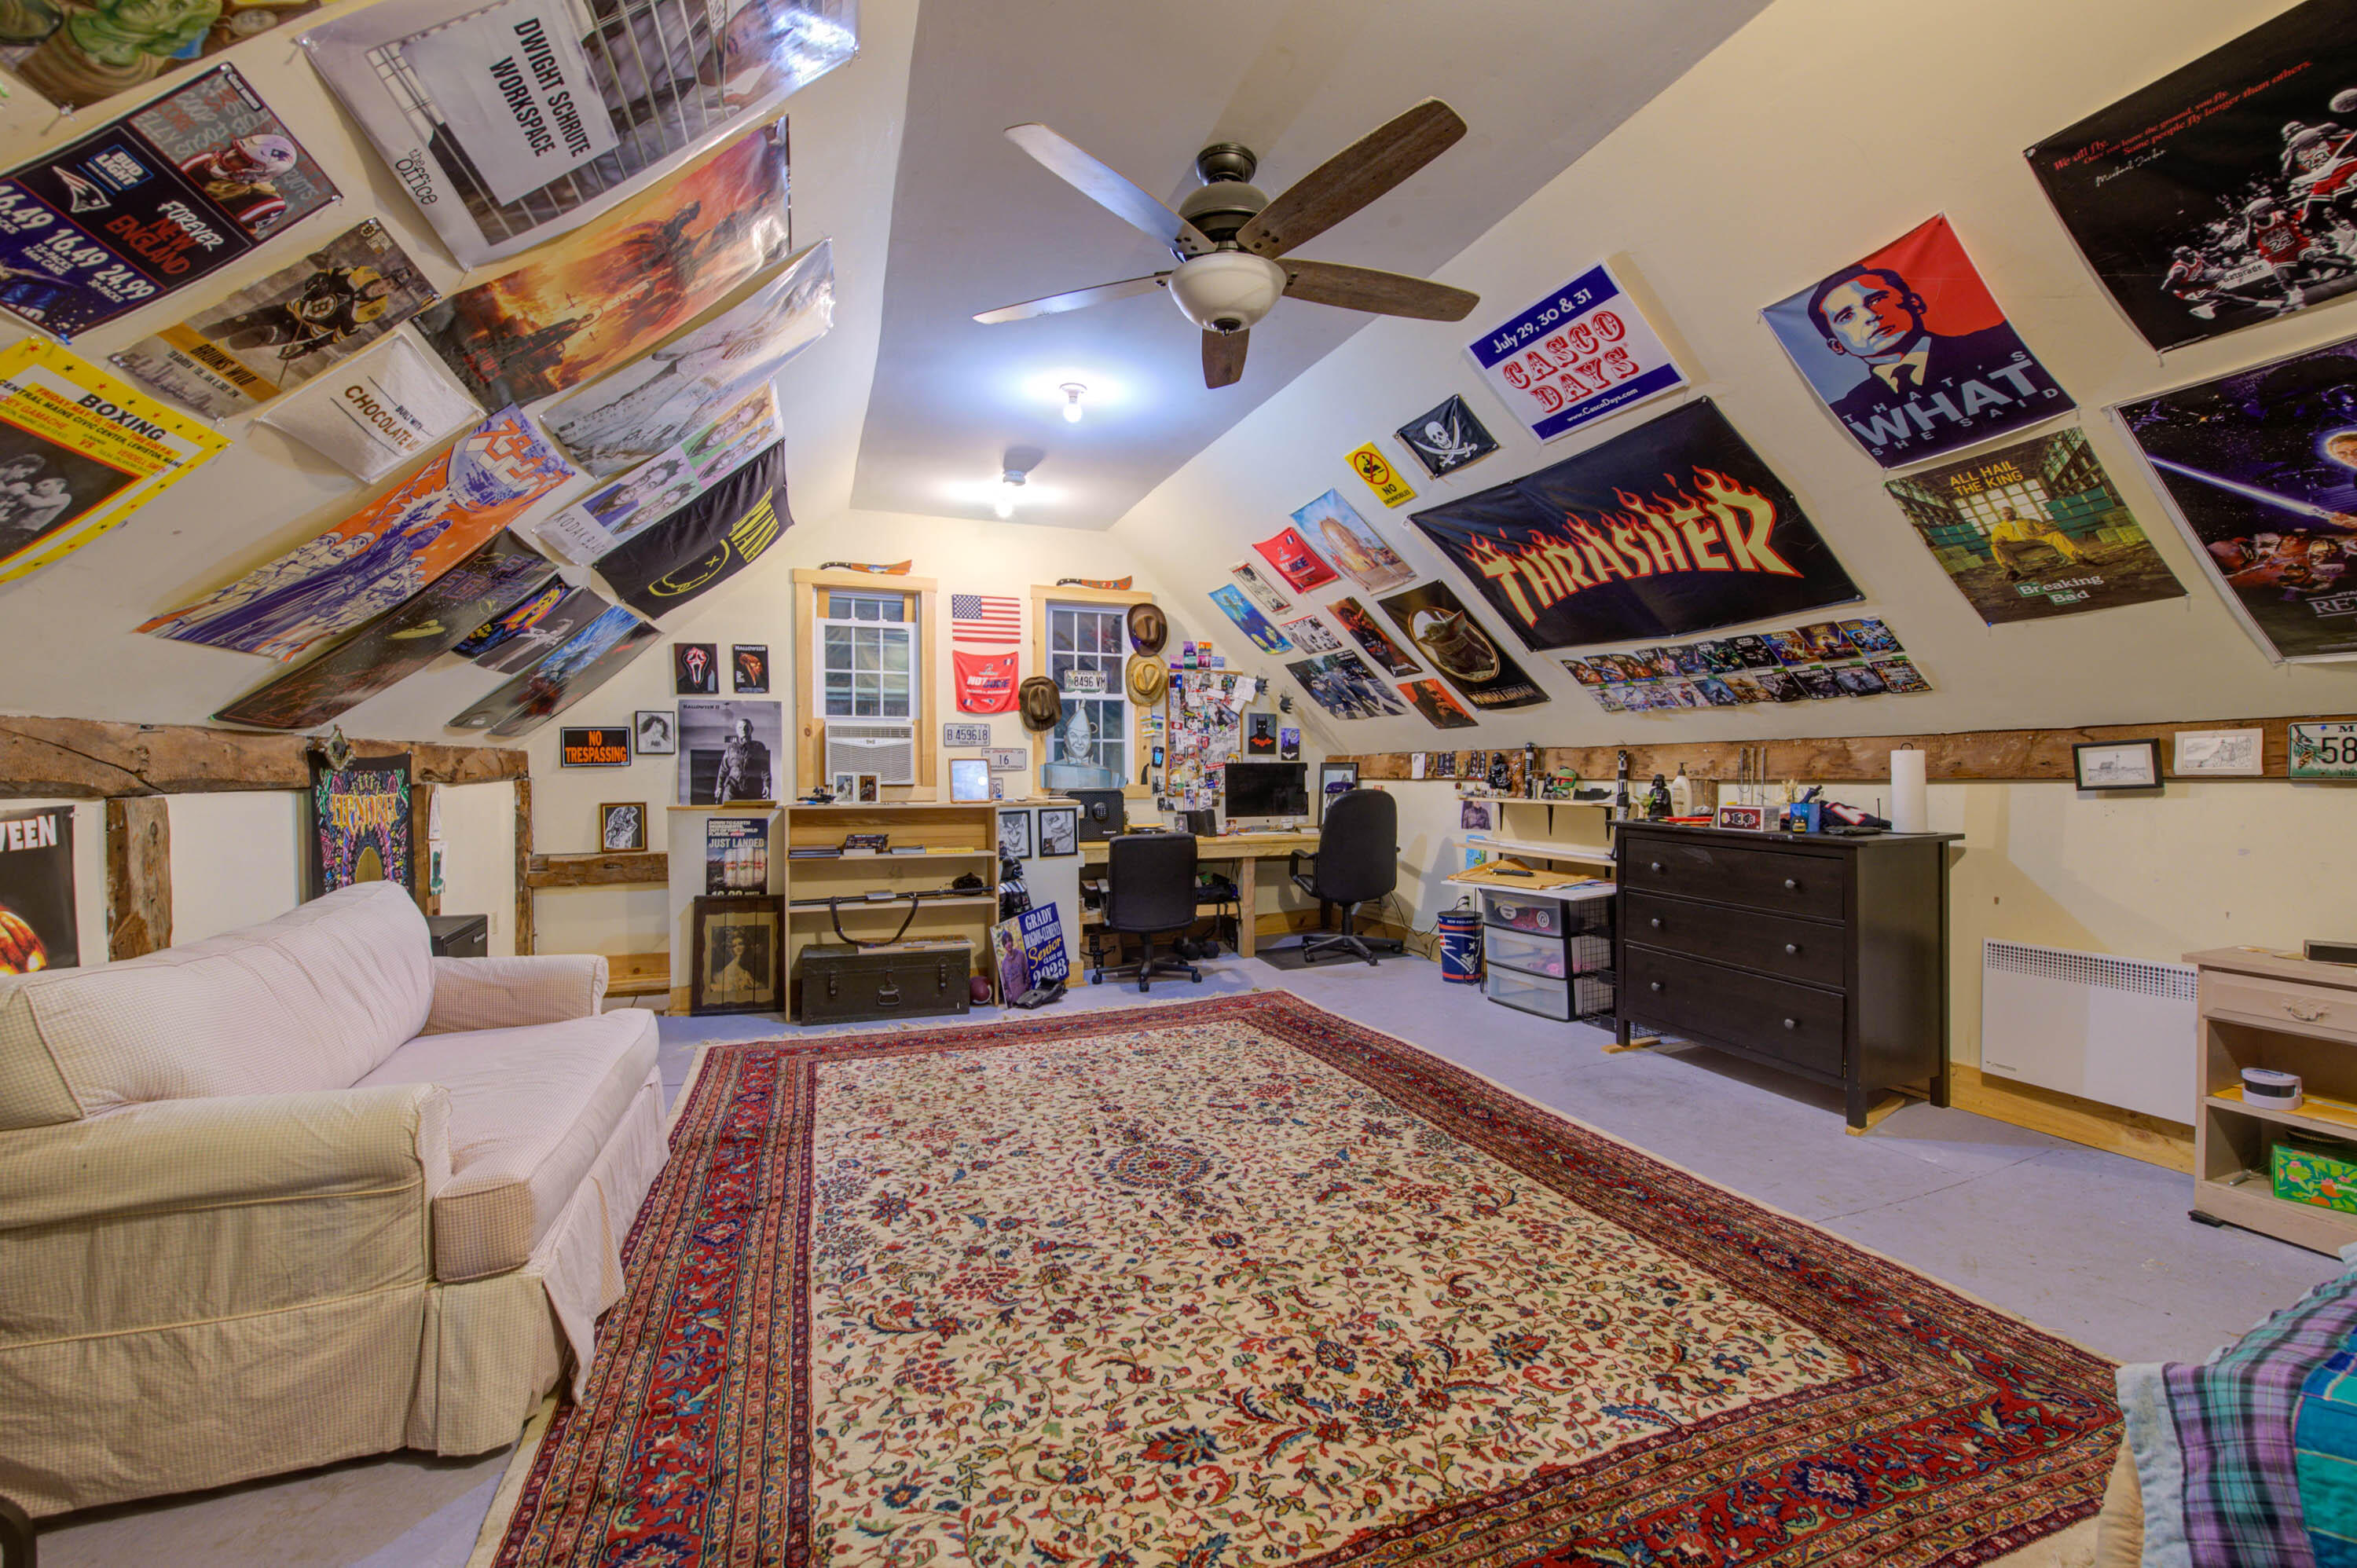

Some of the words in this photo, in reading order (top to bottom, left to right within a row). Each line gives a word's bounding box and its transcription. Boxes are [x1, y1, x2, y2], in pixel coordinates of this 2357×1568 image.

[514, 17, 564, 91] DWIGHT
[547, 89, 592, 158] SCHRUTE
[489, 56, 556, 157] WORKSPACE
[2123, 141, 2150, 156] Some
[2151, 122, 2186, 147] people
[2186, 114, 2203, 130] fly
[2203, 94, 2241, 118] longer
[2242, 81, 2271, 98] than
[2271, 60, 2313, 84] others.
[2121, 134, 2143, 148] leave
[2144, 123, 2159, 136] the
[2195, 100, 2213, 113] you
[94, 153, 138, 186] LIGHT
[111, 151, 145, 177] BUD
[409, 147, 424, 169] the
[2053, 159, 2071, 171] We
[2073, 147, 2090, 163] all
[2088, 138, 2110, 159] fly.
[148, 217, 198, 254] NEW
[157, 200, 225, 252] FOREVER
[45, 228, 109, 267] 16.49
[105, 214, 190, 275] ENGLAND
[93, 263, 156, 300] 24.99
[1493, 331, 1519, 354] July
[1516, 321, 1541, 341] 29,
[1538, 307, 1560, 327] 30
[1560, 297, 1576, 313] &
[1573, 288, 1593, 306] 31
[189, 343, 234, 371] BRUINS
[1502, 310, 1626, 390] CASCO
[1529, 346, 1640, 414] DAYS
[0, 379, 42, 402] CENTRAL
[42, 401, 73, 421] MAINE
[72, 415, 95, 431] CIVIC
[94, 424, 128, 445] CENTER,
[70, 403, 91, 419] MAY
[77, 393, 167, 441] BOXING
[344, 384, 407, 446] CHOCOLATE
[395, 405, 412, 422] BUILT
[1567, 387, 1639, 423] www.CascoDays.com
[1848, 360, 2037, 446] WHAT
[1871, 430, 1935, 456] SHE
[1959, 387, 2059, 427] SAID
[78, 437, 96, 450] VS
[1949, 469, 1980, 487] ALL
[1979, 460, 2021, 479] HAIL
[1953, 481, 1983, 497] THE
[1985, 471, 2025, 491] KING
[1381, 483, 1398, 496] NO
[553, 512, 585, 541] KODAK
[1463, 465, 1802, 628] THRASHER
[2018, 573, 2106, 595] Breaking
[2051, 588, 2091, 605] Bad
[966, 676, 987, 686] NOT
[1074, 676, 1094, 687] 8496
[588, 730, 603, 746] NO
[948, 729, 953, 741] B
[955, 729, 988, 741] 459618
[2320, 736, 2357, 764] 58
[565, 746, 627, 763] TRESPASSING
[999, 754, 1010, 765] 16
[709, 837, 730, 848] JUST
[732, 837, 765, 848] LANDED
[1025, 907, 1053, 931] GRADY
[1028, 936, 1061, 969] Senior
[1043, 953, 1057, 965] CLASS
[1057, 950, 1063, 958] OF
